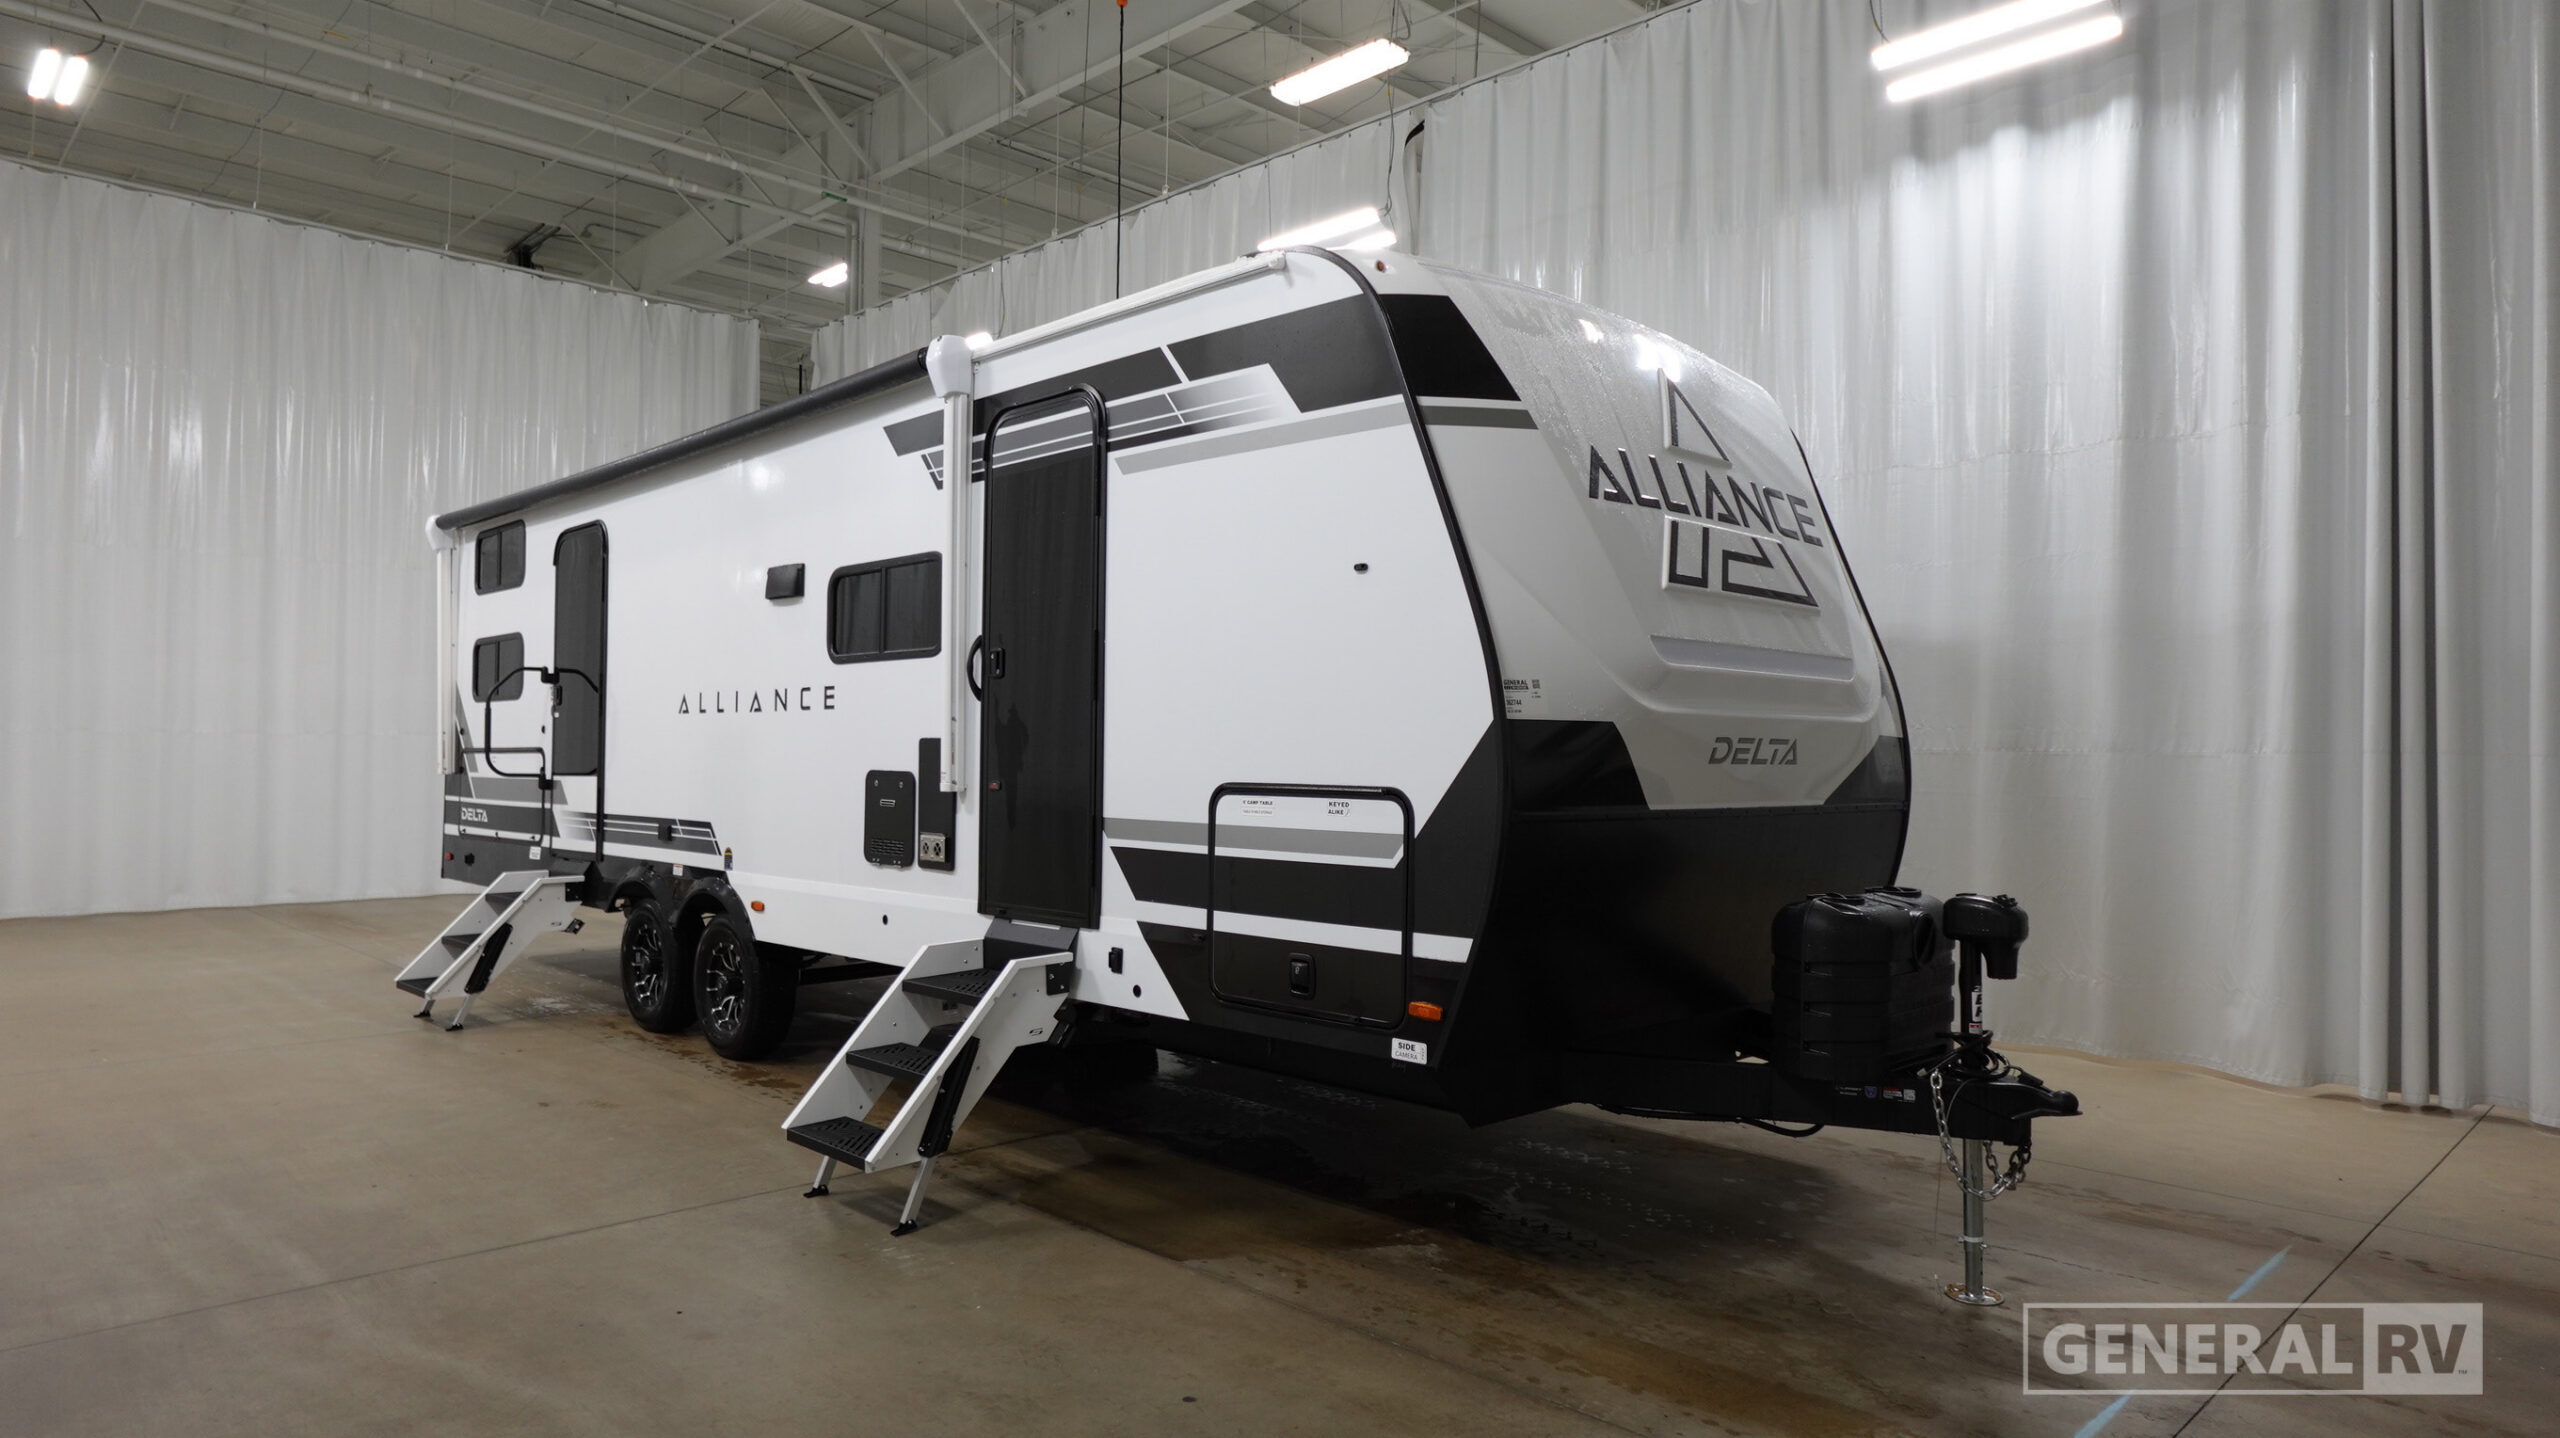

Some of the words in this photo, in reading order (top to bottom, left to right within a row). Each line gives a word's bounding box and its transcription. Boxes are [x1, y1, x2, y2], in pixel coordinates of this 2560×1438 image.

[1588, 444, 1824, 548] ALLIANCE
[678, 684, 836, 714] ALLIANCE
[1707, 736, 1799, 766] DELTA
[461, 806, 489, 823] DELTA
[1395, 1050, 1417, 1060] CAMERA
[1398, 1042, 1416, 1051] SIDE
